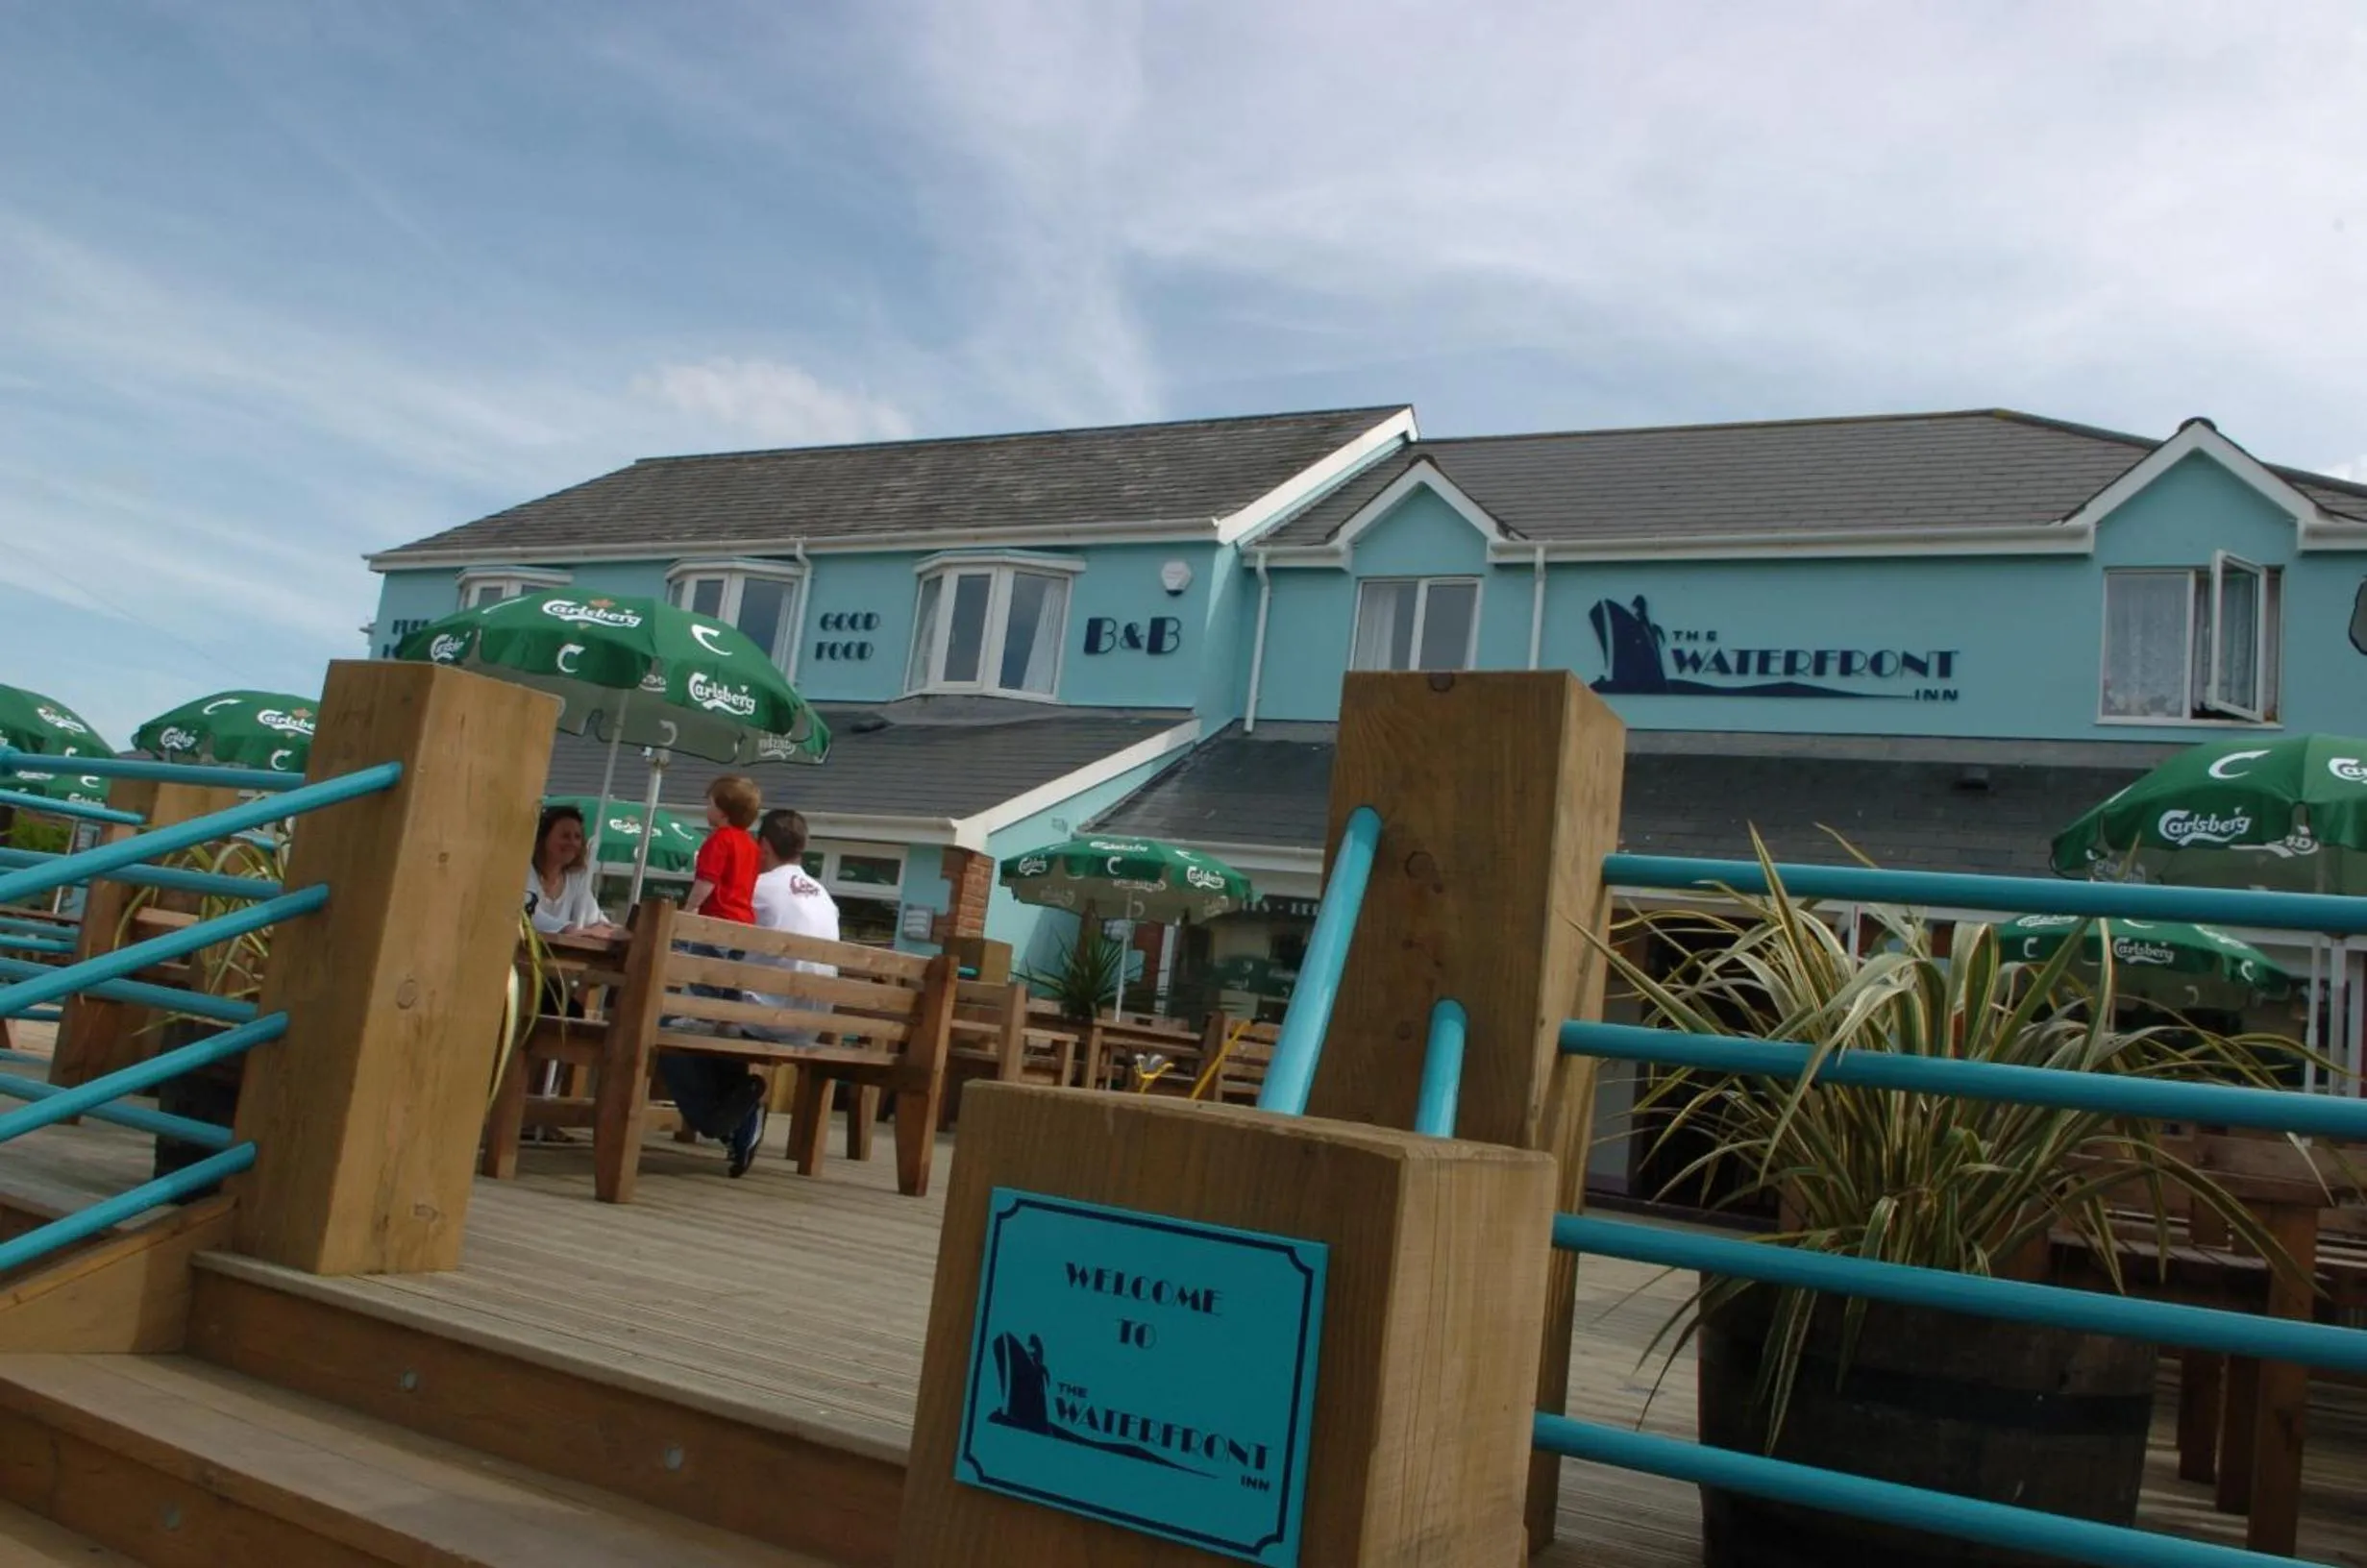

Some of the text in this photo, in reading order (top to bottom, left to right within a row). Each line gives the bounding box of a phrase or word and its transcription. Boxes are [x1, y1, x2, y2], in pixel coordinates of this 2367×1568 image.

[542, 600, 642, 627] Carlsberg
[820, 612, 880, 631] GOOD
[1083, 617, 1181, 655] B&B
[1673, 630, 1717, 642] THE
[815, 642, 874, 661] FOOD
[1671, 648, 1960, 678] WATERFRONT
[688, 672, 756, 716] Carlsberg
[1914, 689, 1959, 702] INN
[258, 709, 315, 736] Carlsbe
[2158, 806, 2253, 845] Carlsberg
[1187, 866, 1225, 889] Carlsberg
[2114, 937, 2174, 964] Carlsberg
[1066, 1262, 1223, 1315] WELCOME
[1117, 1318, 1157, 1350] TO
[1058, 1382, 1088, 1399] THE
[1055, 1398, 1271, 1471] WATERFRONT
[1240, 1475, 1271, 1493] INN
